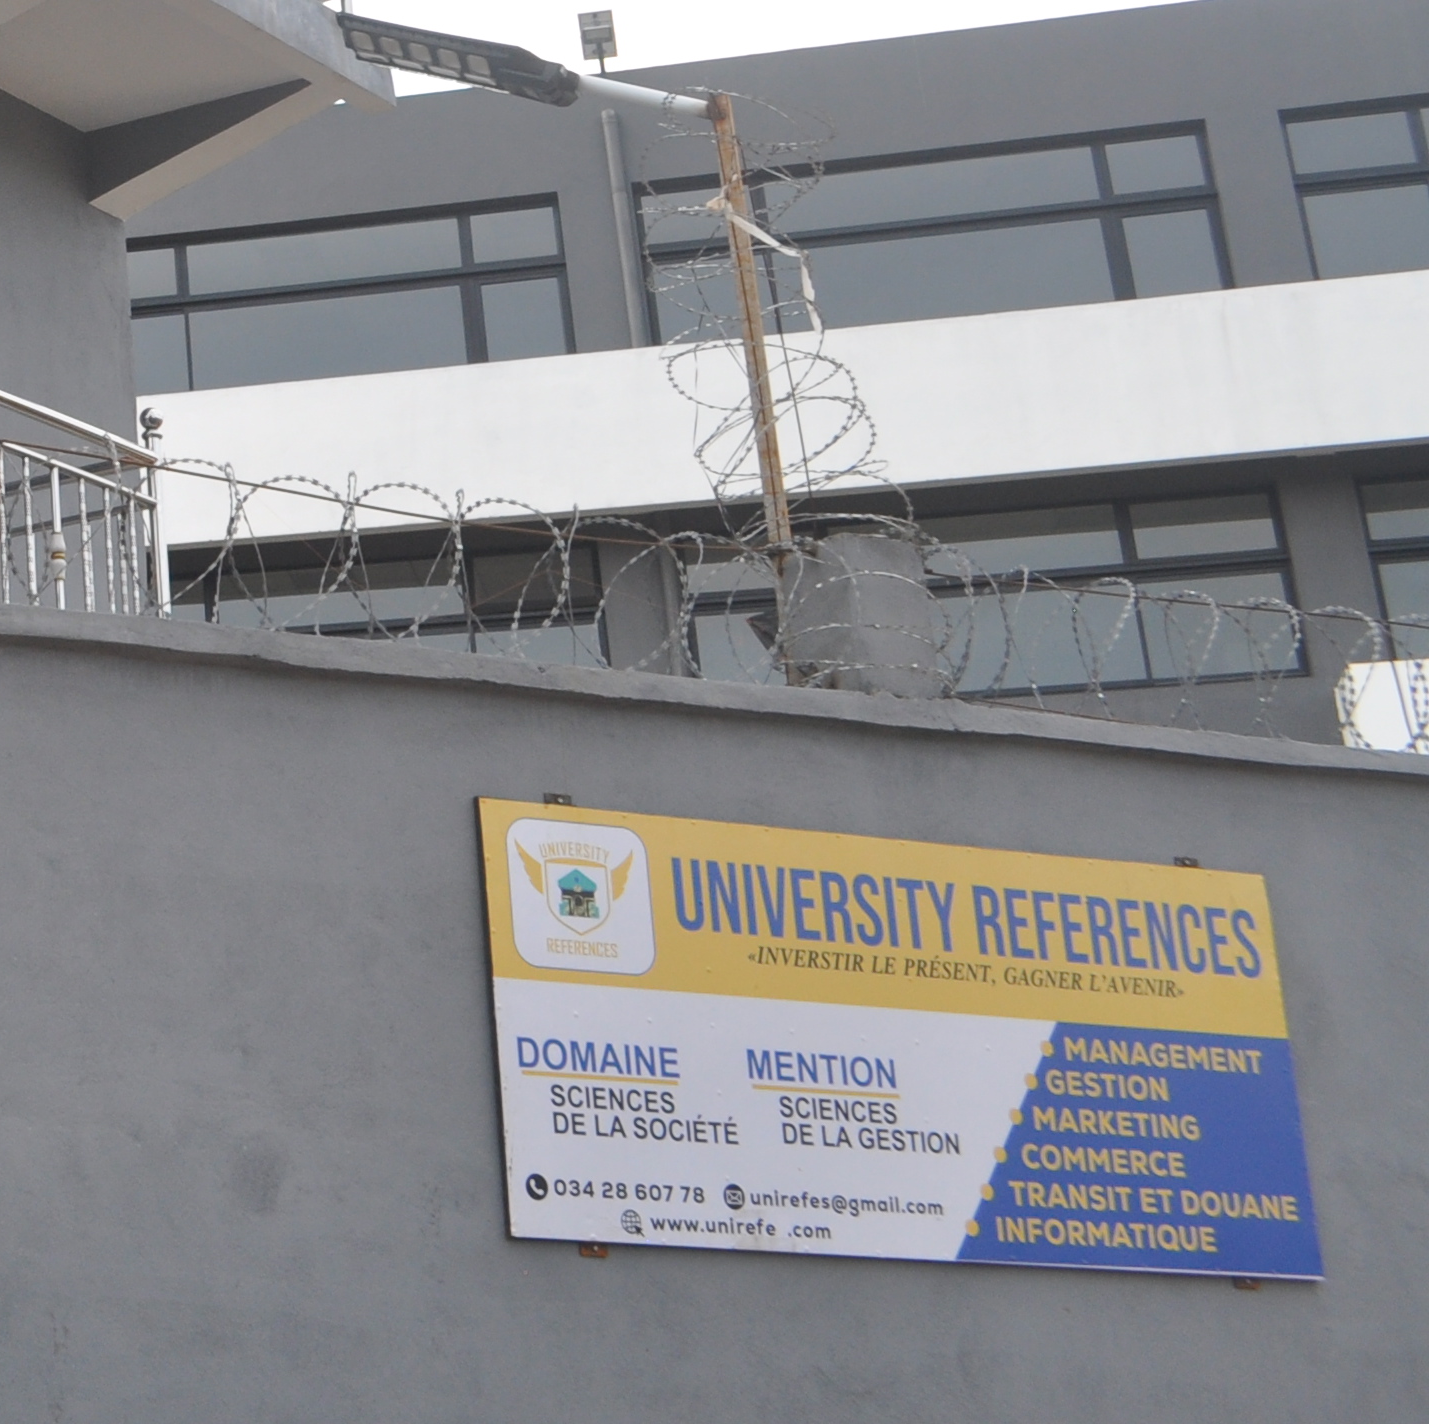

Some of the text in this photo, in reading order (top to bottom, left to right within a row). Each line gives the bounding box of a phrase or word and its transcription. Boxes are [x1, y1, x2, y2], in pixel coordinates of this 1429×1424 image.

[538, 841, 610, 863] UNIVERSITY
[670, 856, 1261, 978] UNIVERSITY REFERENCES
[546, 937, 619, 958] REFERENCES
[870, 955, 896, 975] LE
[904, 956, 997, 987] PRÉSENT,
[1003, 966, 1083, 991] GAGNER
[517, 1036, 680, 1078] DOMAINE
[746, 1048, 897, 1089] MENTION
[1063, 1036, 1262, 1075] MANAGEMENT
[550, 1084, 675, 1114] SCIENCES
[1045, 1068, 1171, 1102] GESTION
[552, 1111, 739, 1145] DE LA SOCIÉTÉ
[779, 1096, 898, 1124] SCIENCES
[1032, 1105, 1201, 1141] MARKETING
[781, 1123, 961, 1155] DE LA GESTION
[1021, 1143, 1187, 1178] COMMERCE
[554, 1179, 944, 1217] 034 28 607 78 unirefes@gmail.com
[1008, 1180, 1300, 1222] TRANSIT ET DOUANE
[996, 1216, 1219, 1253] INFORMATIQUE
